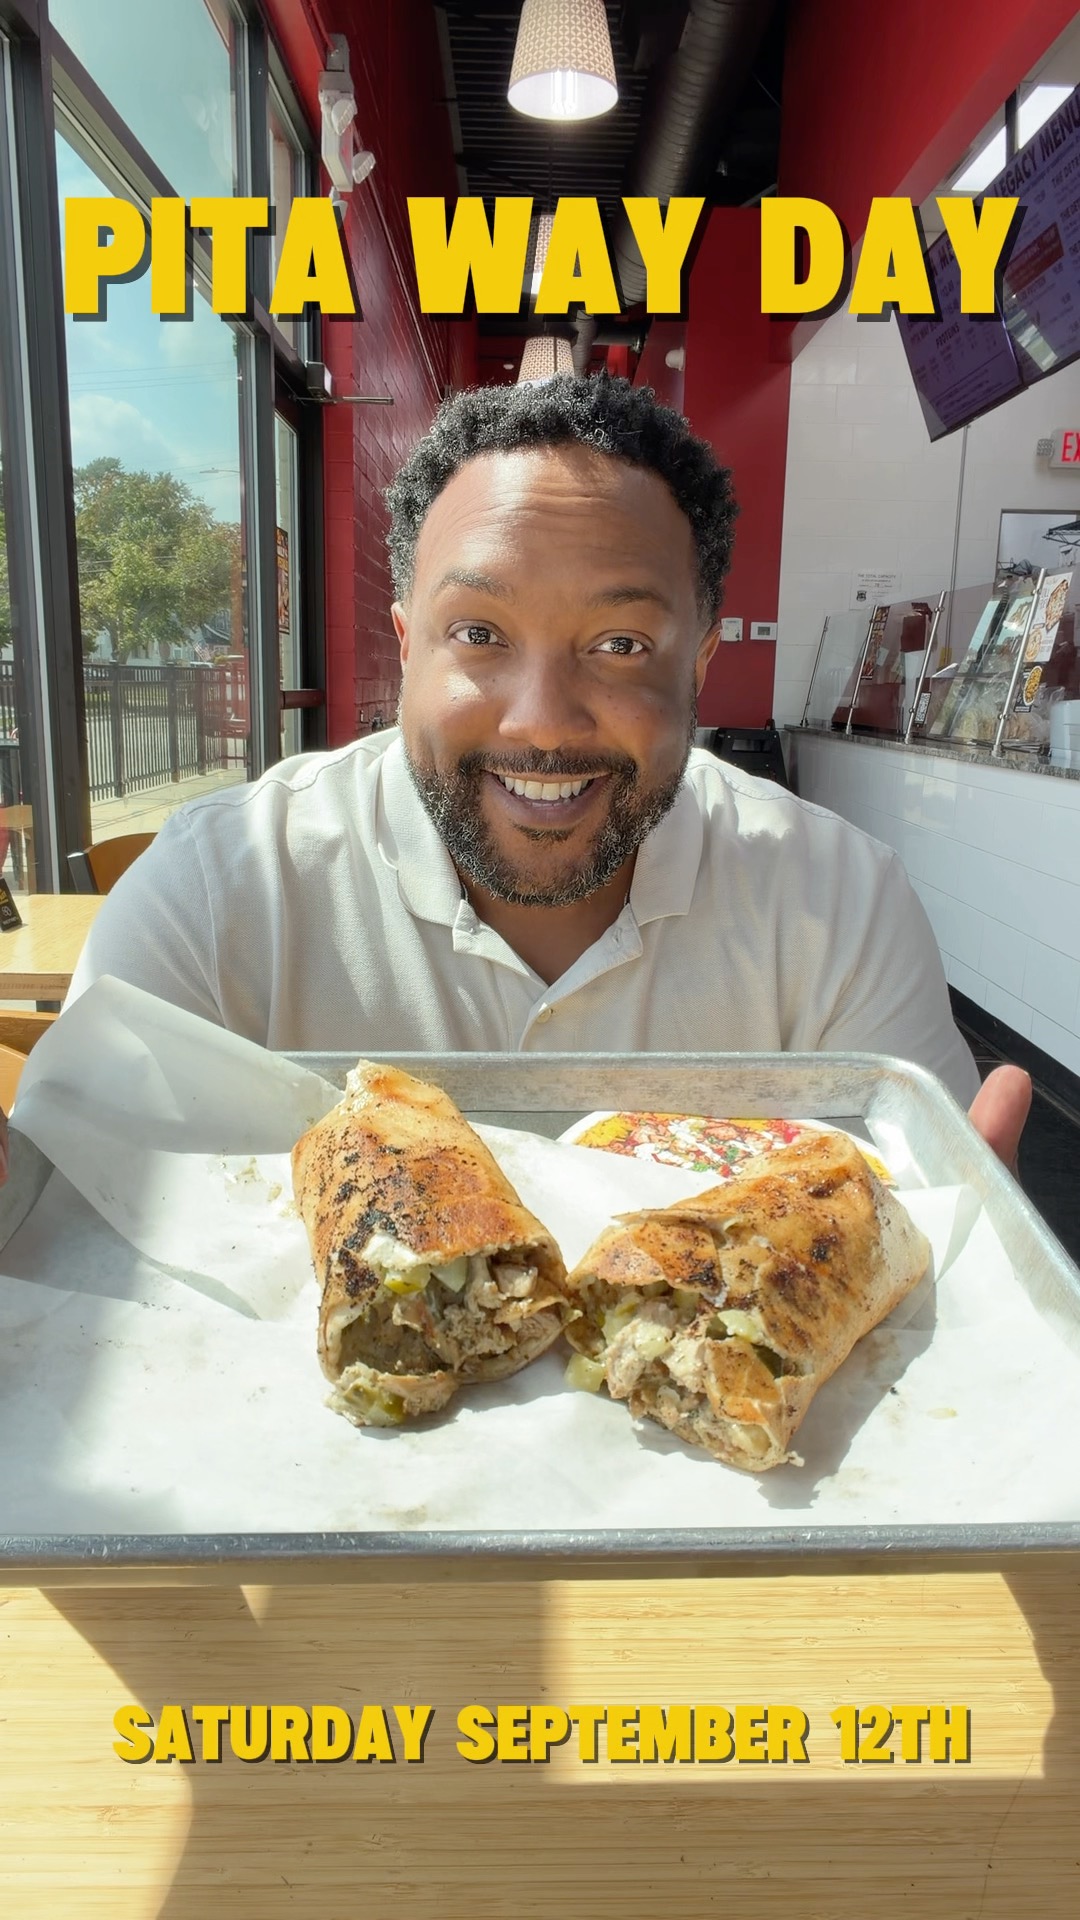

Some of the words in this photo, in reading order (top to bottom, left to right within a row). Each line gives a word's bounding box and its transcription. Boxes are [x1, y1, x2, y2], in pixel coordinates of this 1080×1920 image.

[993, 155, 1038, 198] LEGACY
[1039, 94, 1080, 162] MENU
[935, 322, 960, 348] PROTEINS
